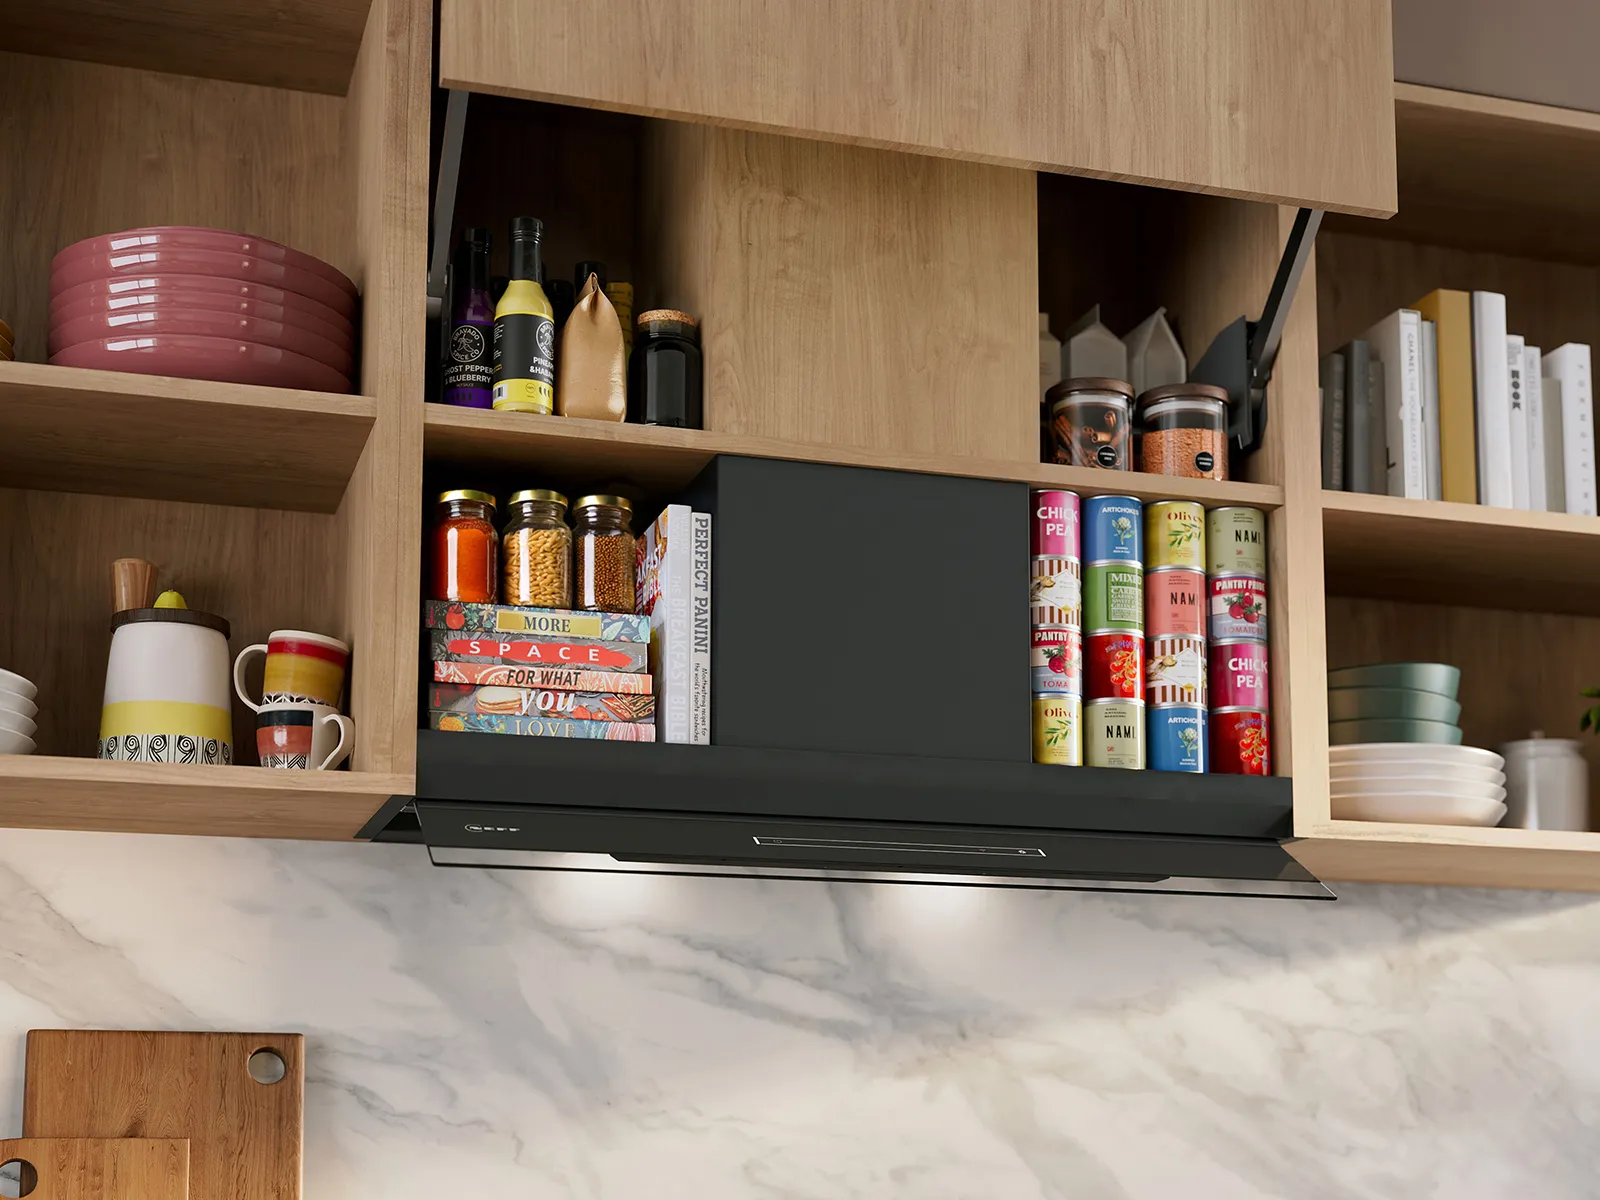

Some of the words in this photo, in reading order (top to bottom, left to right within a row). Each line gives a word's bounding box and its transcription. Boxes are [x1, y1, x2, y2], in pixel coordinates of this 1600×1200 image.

[453, 327, 480, 342] BRAVADO
[1407, 333, 1415, 373] CHANEL
[449, 374, 492, 383] BLUEBERRY
[1037, 506, 1078, 523] CHICK
[1102, 506, 1139, 516] ARTICHOKES
[1046, 523, 1073, 537] PEA
[694, 517, 709, 592] PERFECT
[672, 575, 681, 594] THE
[1111, 572, 1142, 585] MIXED
[1216, 580, 1247, 591] PANTRY
[523, 616, 571, 633] MORE
[694, 596, 709, 653] PANINI
[670, 597, 687, 689] BREAKFAST
[1035, 631, 1068, 642] PANTRY
[469, 641, 600, 662] SPACE
[1228, 658, 1268, 673] CHICK
[506, 669, 535, 685] FOR
[540, 670, 581, 686] WHAT
[1237, 675, 1263, 688] PEA
[515, 691, 578, 716] you
[670, 696, 687, 741] BIBLE
[514, 720, 577, 738] LOVE
